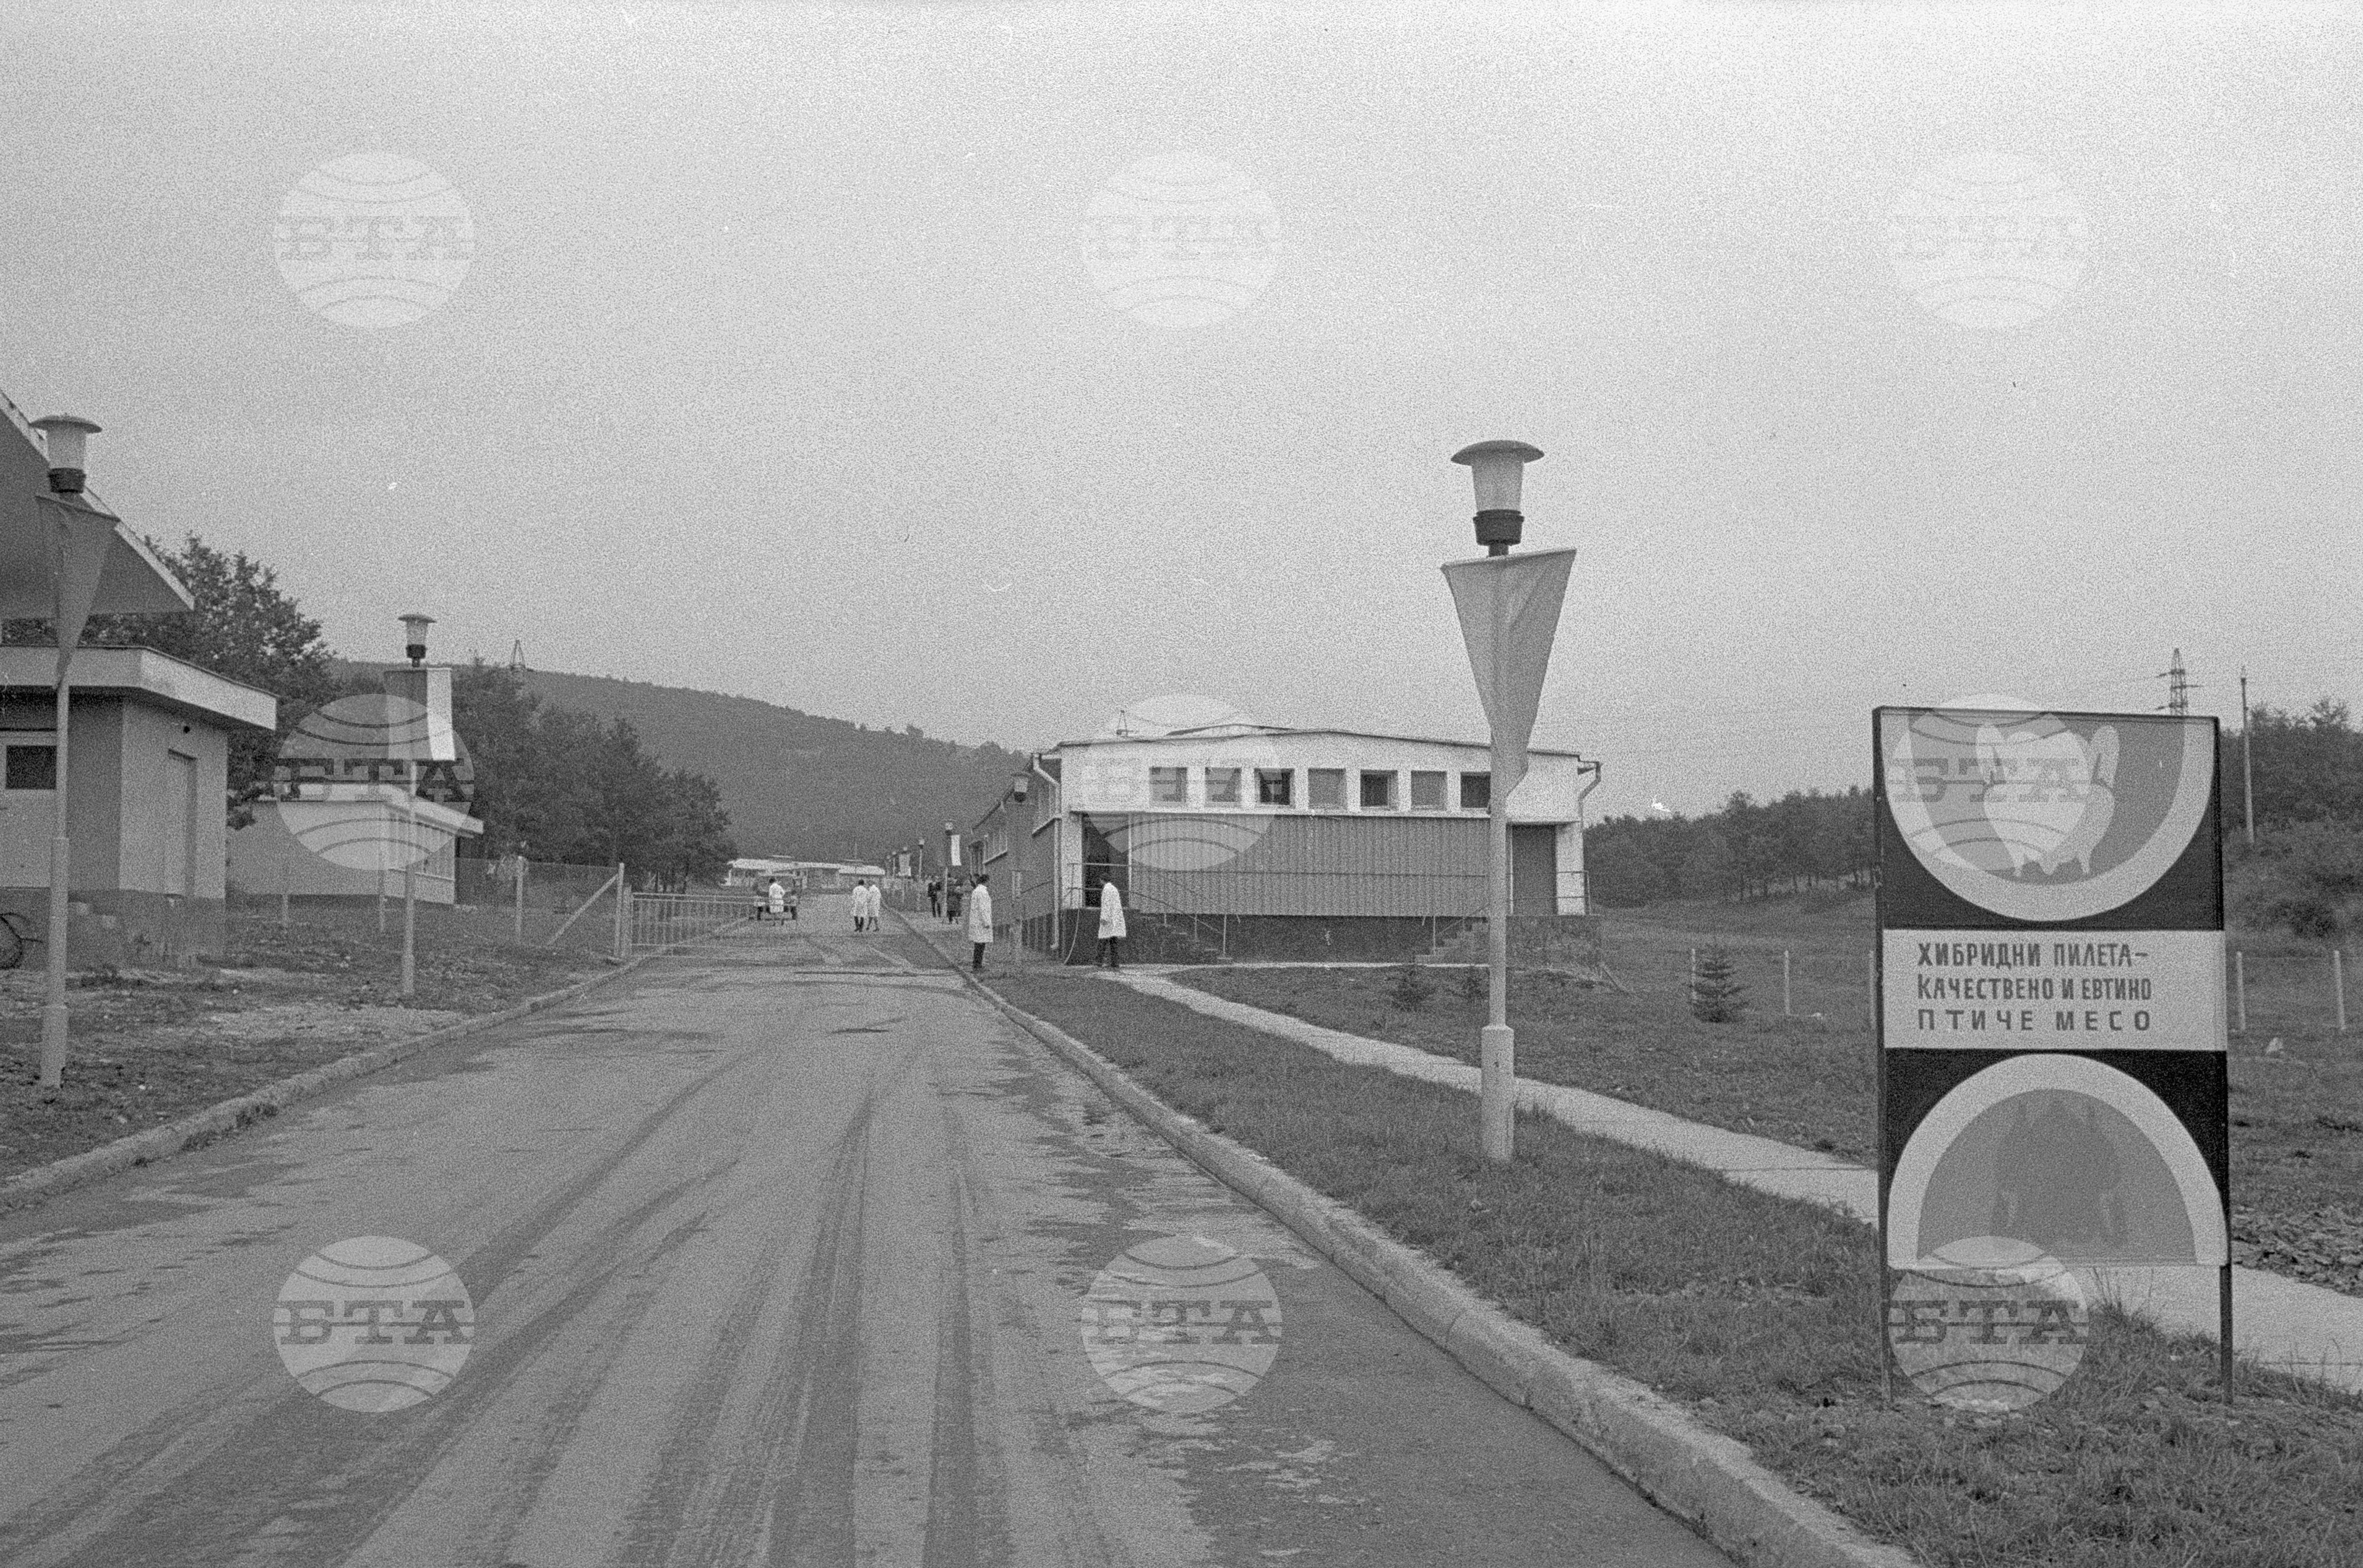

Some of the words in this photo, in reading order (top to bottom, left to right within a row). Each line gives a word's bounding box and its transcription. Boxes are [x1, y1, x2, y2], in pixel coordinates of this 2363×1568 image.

[1917, 943, 2040, 969] ХИБРИДНИ
[1917, 974, 2054, 1000] КАЧЕСТВЕНО
[2062, 979, 2074, 1000] И
[2081, 978, 2152, 1000] ЕВТИНО
[1918, 1009, 2033, 1031] ПТИЧЕ
[2056, 1010, 2150, 1031] МЕСО
